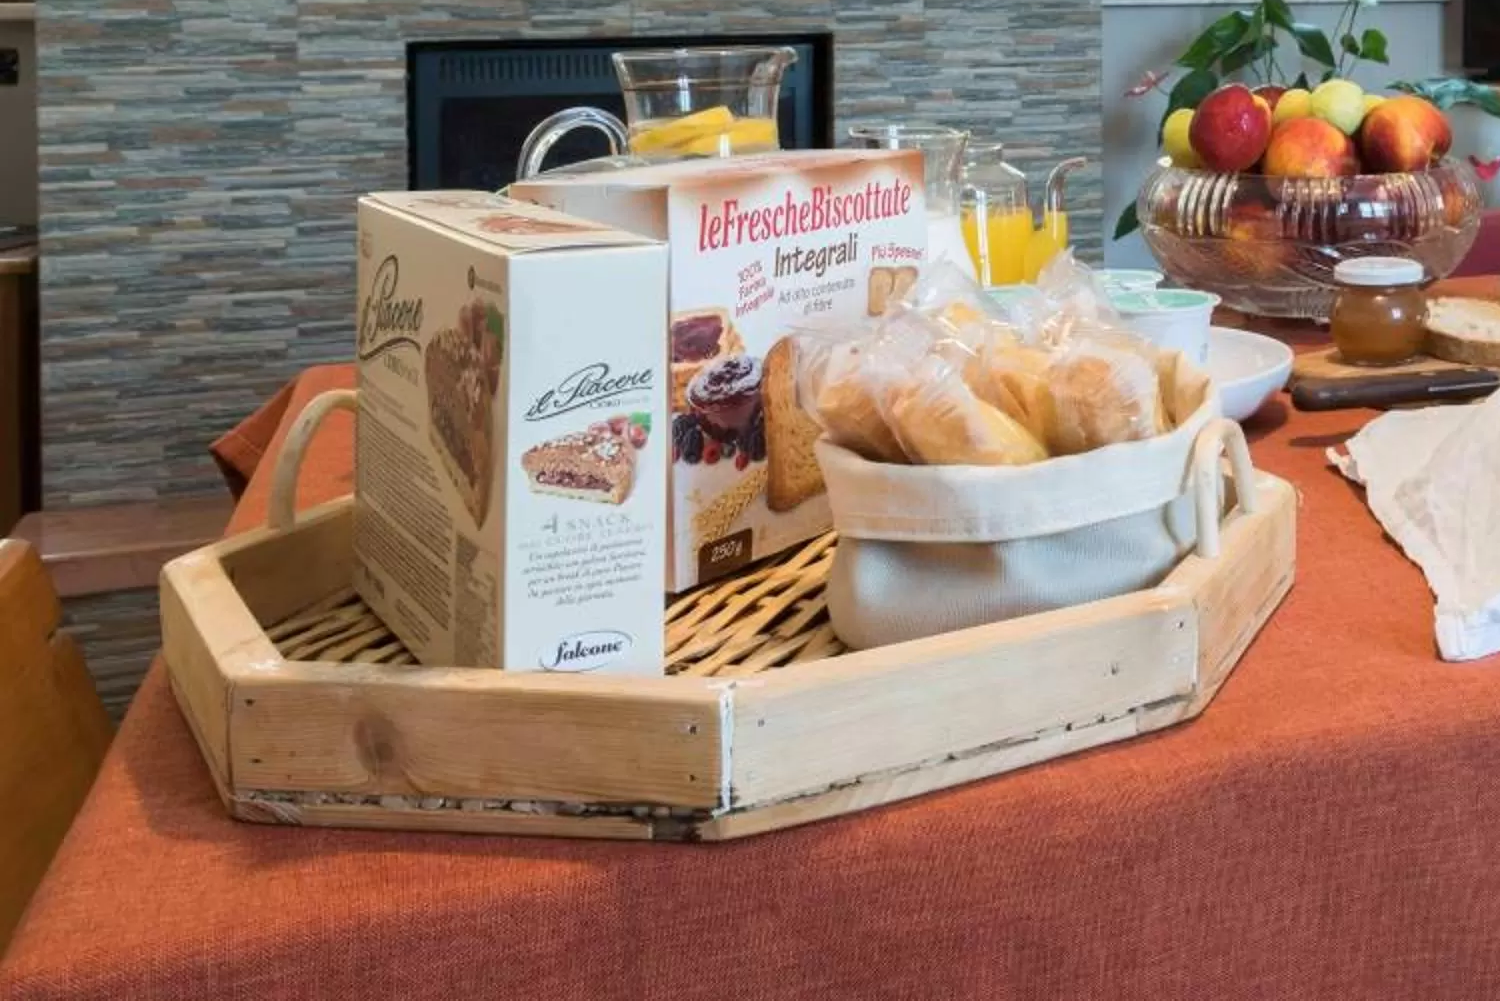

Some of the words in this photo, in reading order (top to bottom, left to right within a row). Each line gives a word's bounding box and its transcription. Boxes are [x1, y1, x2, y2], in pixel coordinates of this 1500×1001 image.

[773, 233, 859, 278] Integrali
[523, 389, 555, 418] il
[553, 362, 653, 408] Piacere
[552, 640, 624, 667] falcone
